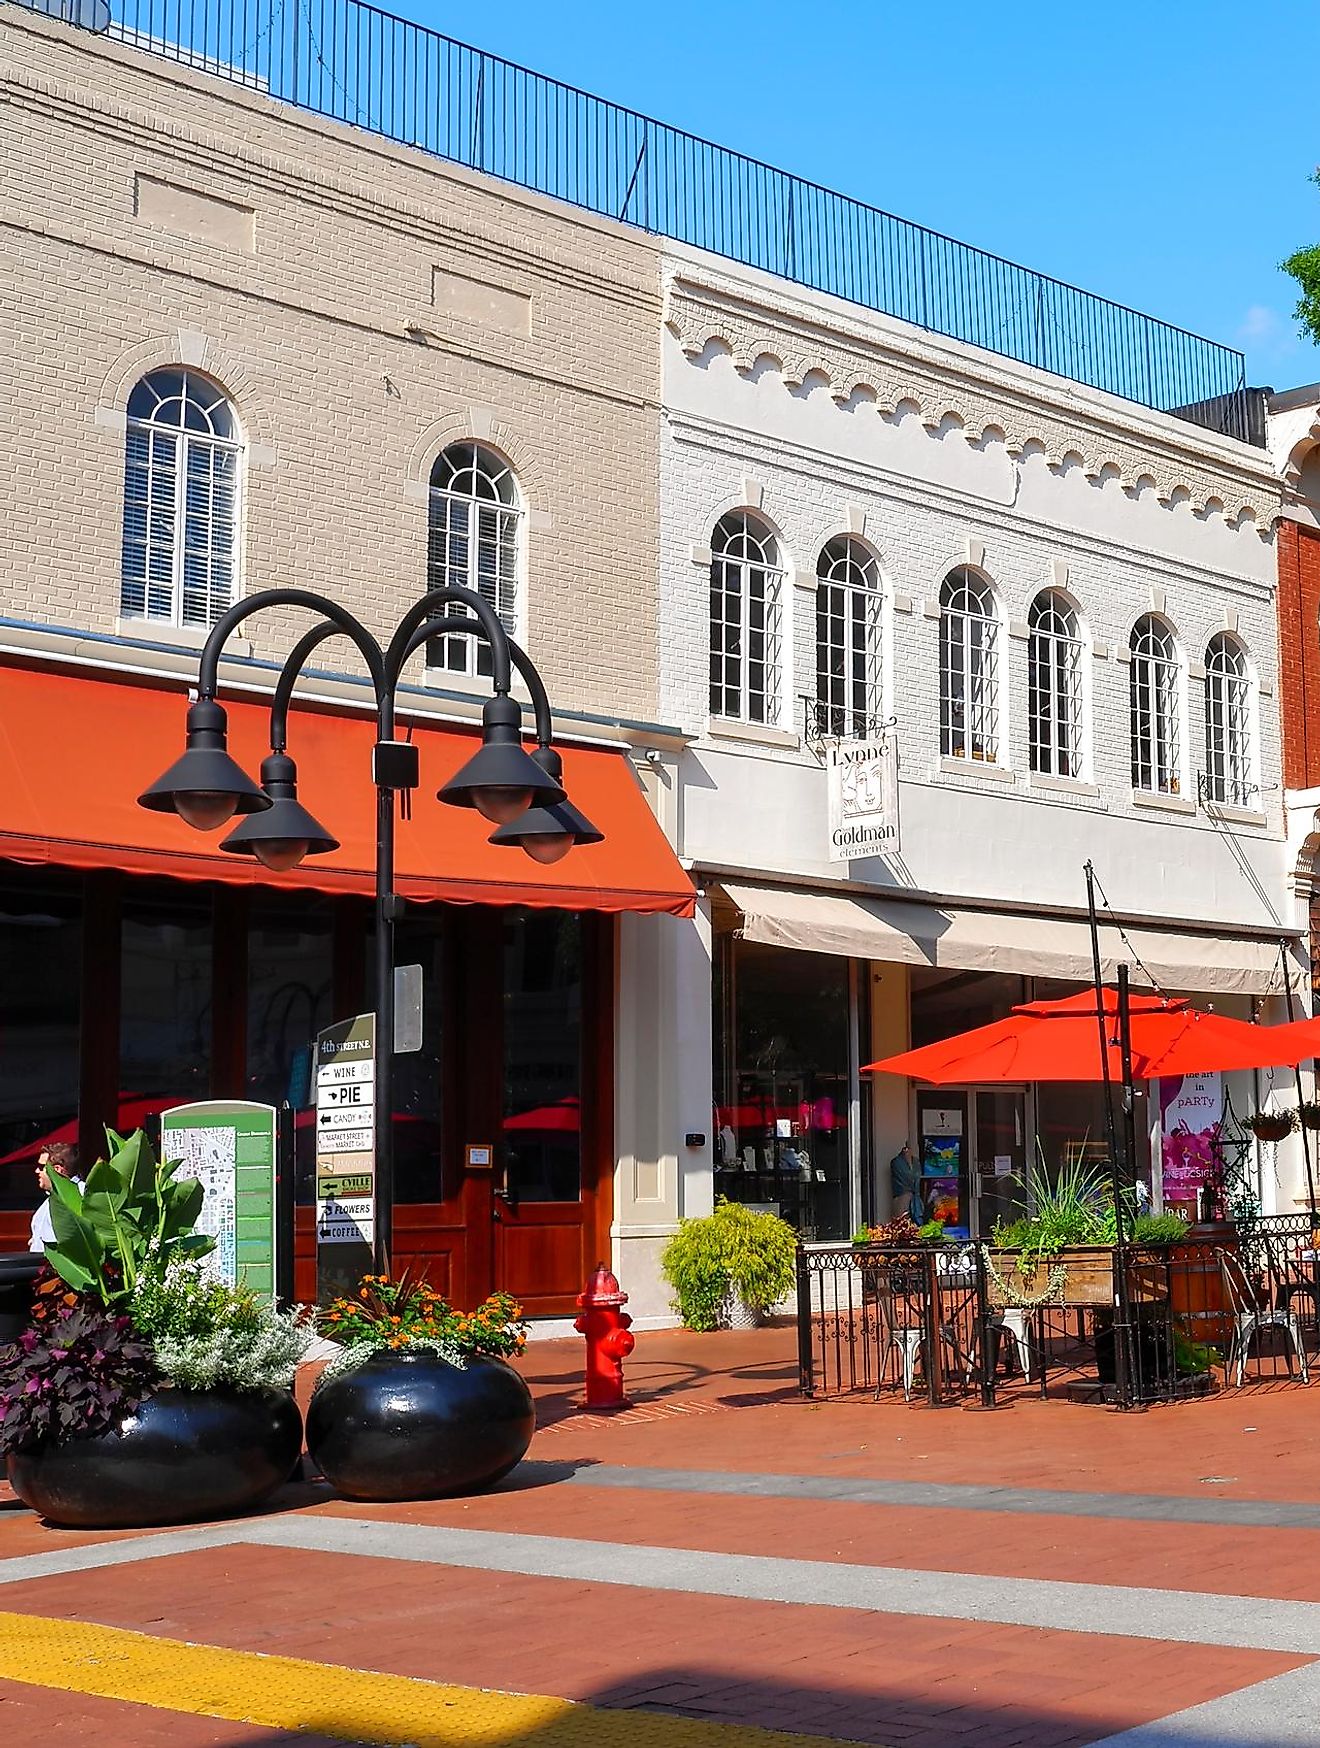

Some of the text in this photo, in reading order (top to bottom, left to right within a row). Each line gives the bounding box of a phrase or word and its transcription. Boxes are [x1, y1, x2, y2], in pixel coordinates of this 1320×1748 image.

[832, 744, 889, 769] Lynne
[832, 824, 896, 847] Goldman
[321, 1040, 335, 1054] 4th
[333, 1066, 356, 1079] WINE
[1195, 1082, 1205, 1091] in
[340, 1086, 361, 1104] PIE
[1178, 1096, 1215, 1108] pARTy
[333, 1113, 356, 1124] CANDY
[341, 1177, 371, 1188] CVILLE
[334, 1204, 371, 1215] FLOWERS
[332, 1227, 361, 1238] COFFEE
